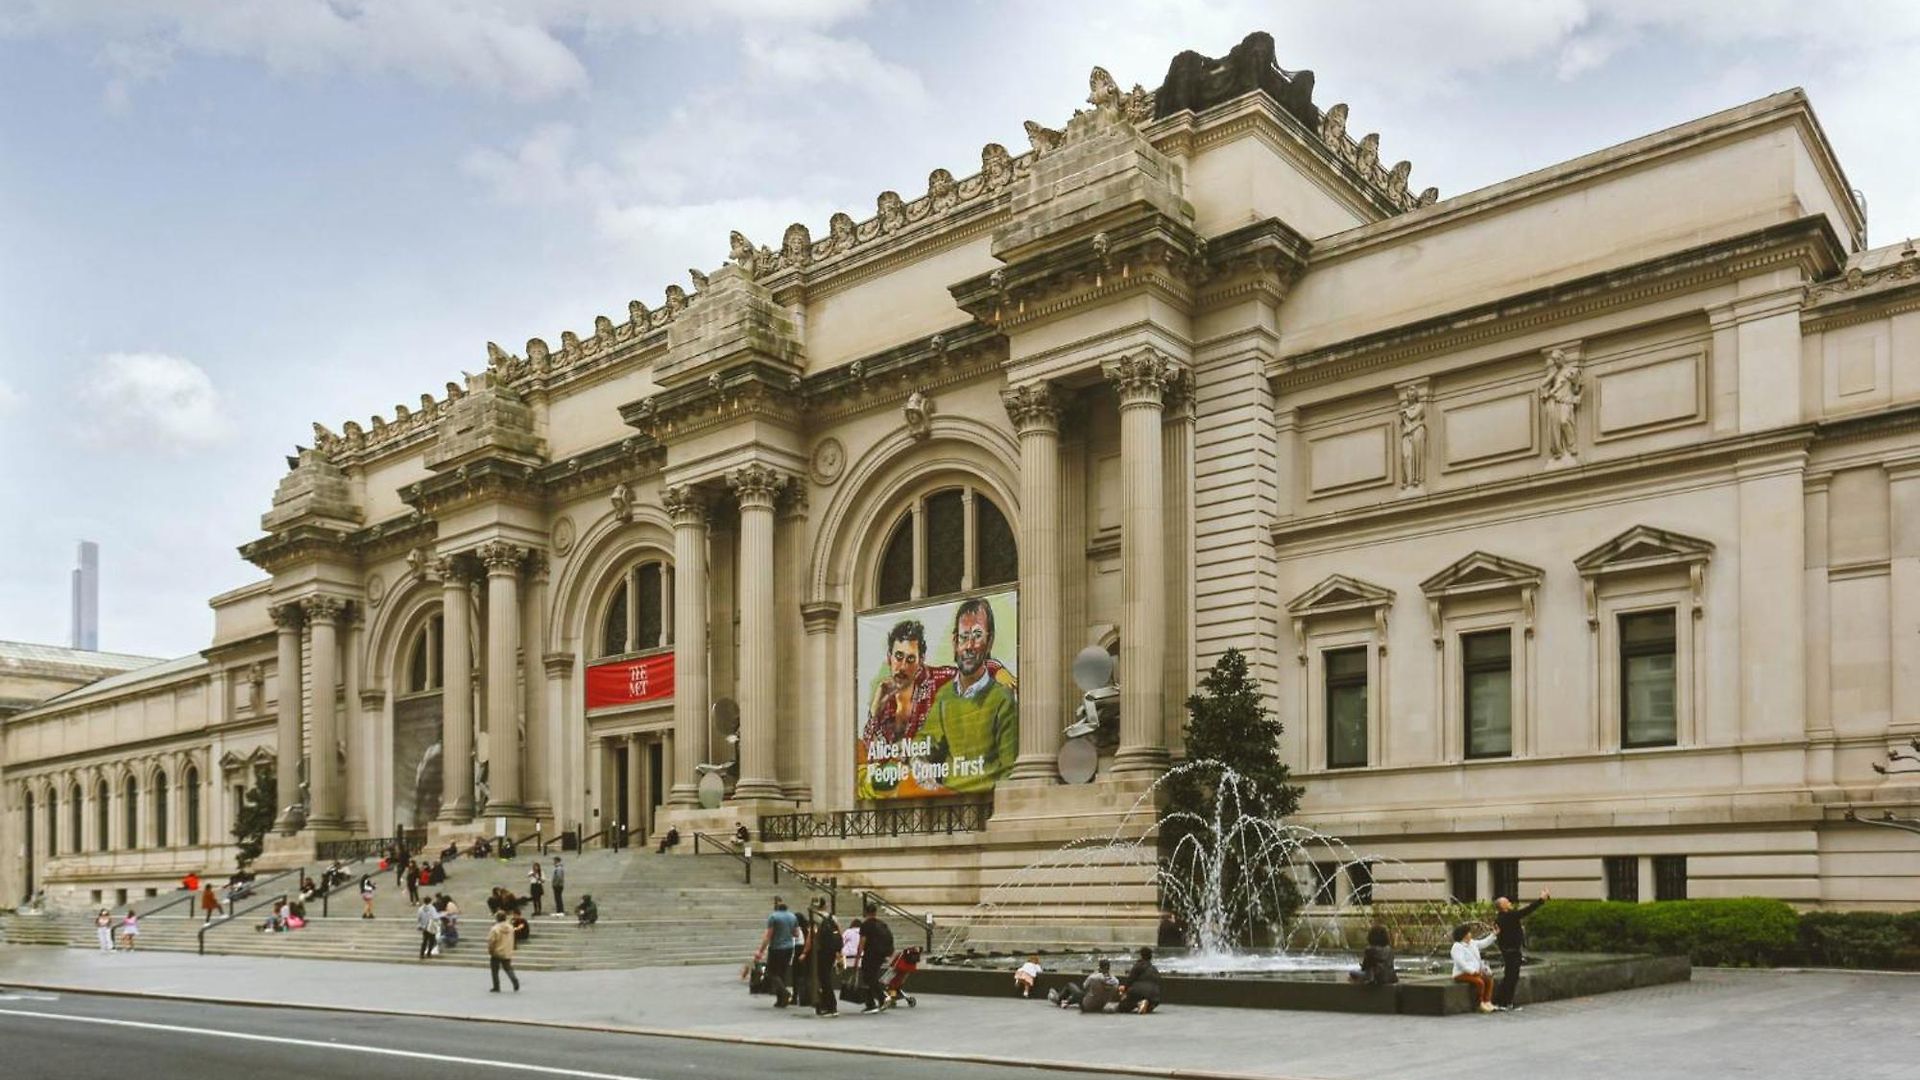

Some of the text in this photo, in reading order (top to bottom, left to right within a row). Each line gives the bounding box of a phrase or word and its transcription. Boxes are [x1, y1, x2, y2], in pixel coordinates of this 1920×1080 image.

[629, 664, 648, 681] THE
[629, 680, 649, 697] MET
[868, 736, 931, 761] Alice Neel
[867, 755, 985, 786] People Come First
